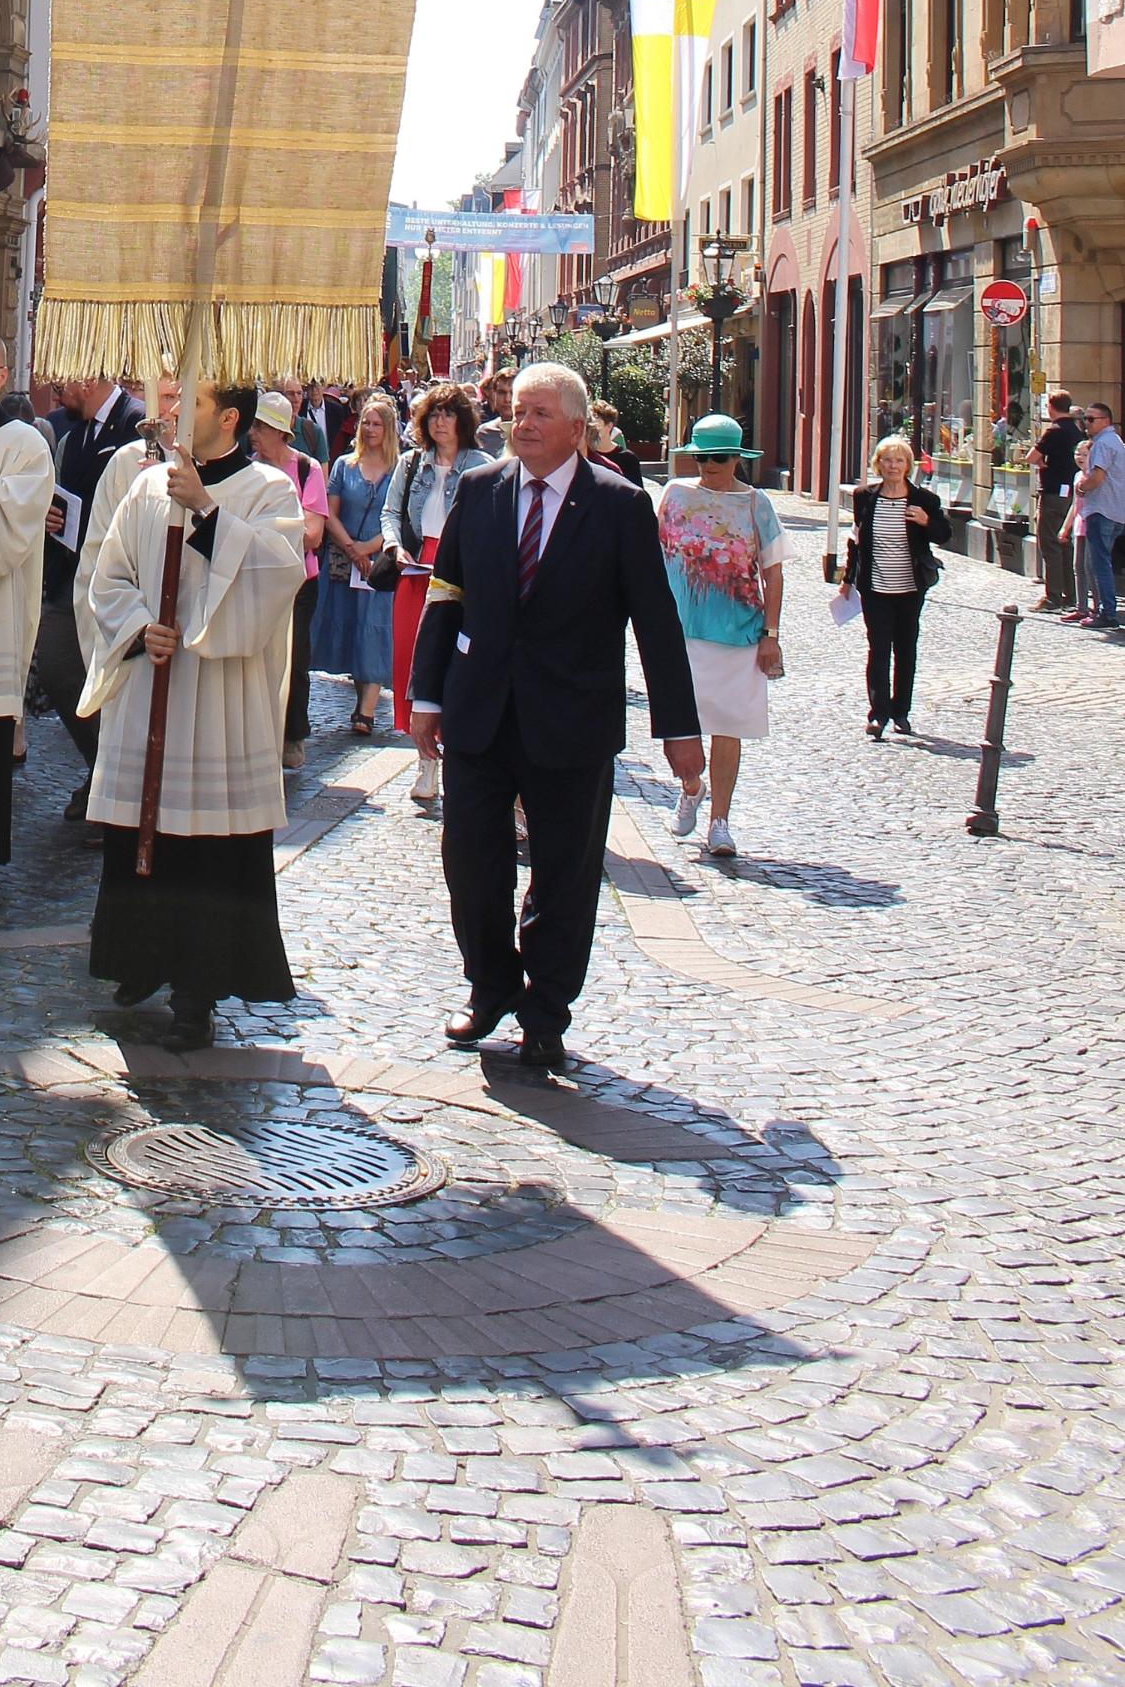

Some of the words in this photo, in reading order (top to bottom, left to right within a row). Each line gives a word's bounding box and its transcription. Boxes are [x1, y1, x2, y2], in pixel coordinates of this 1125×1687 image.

[405, 217, 430, 225] BESTE
[496, 221, 539, 229] KONZERTE
[462, 227, 503, 236] ENTFERNT
